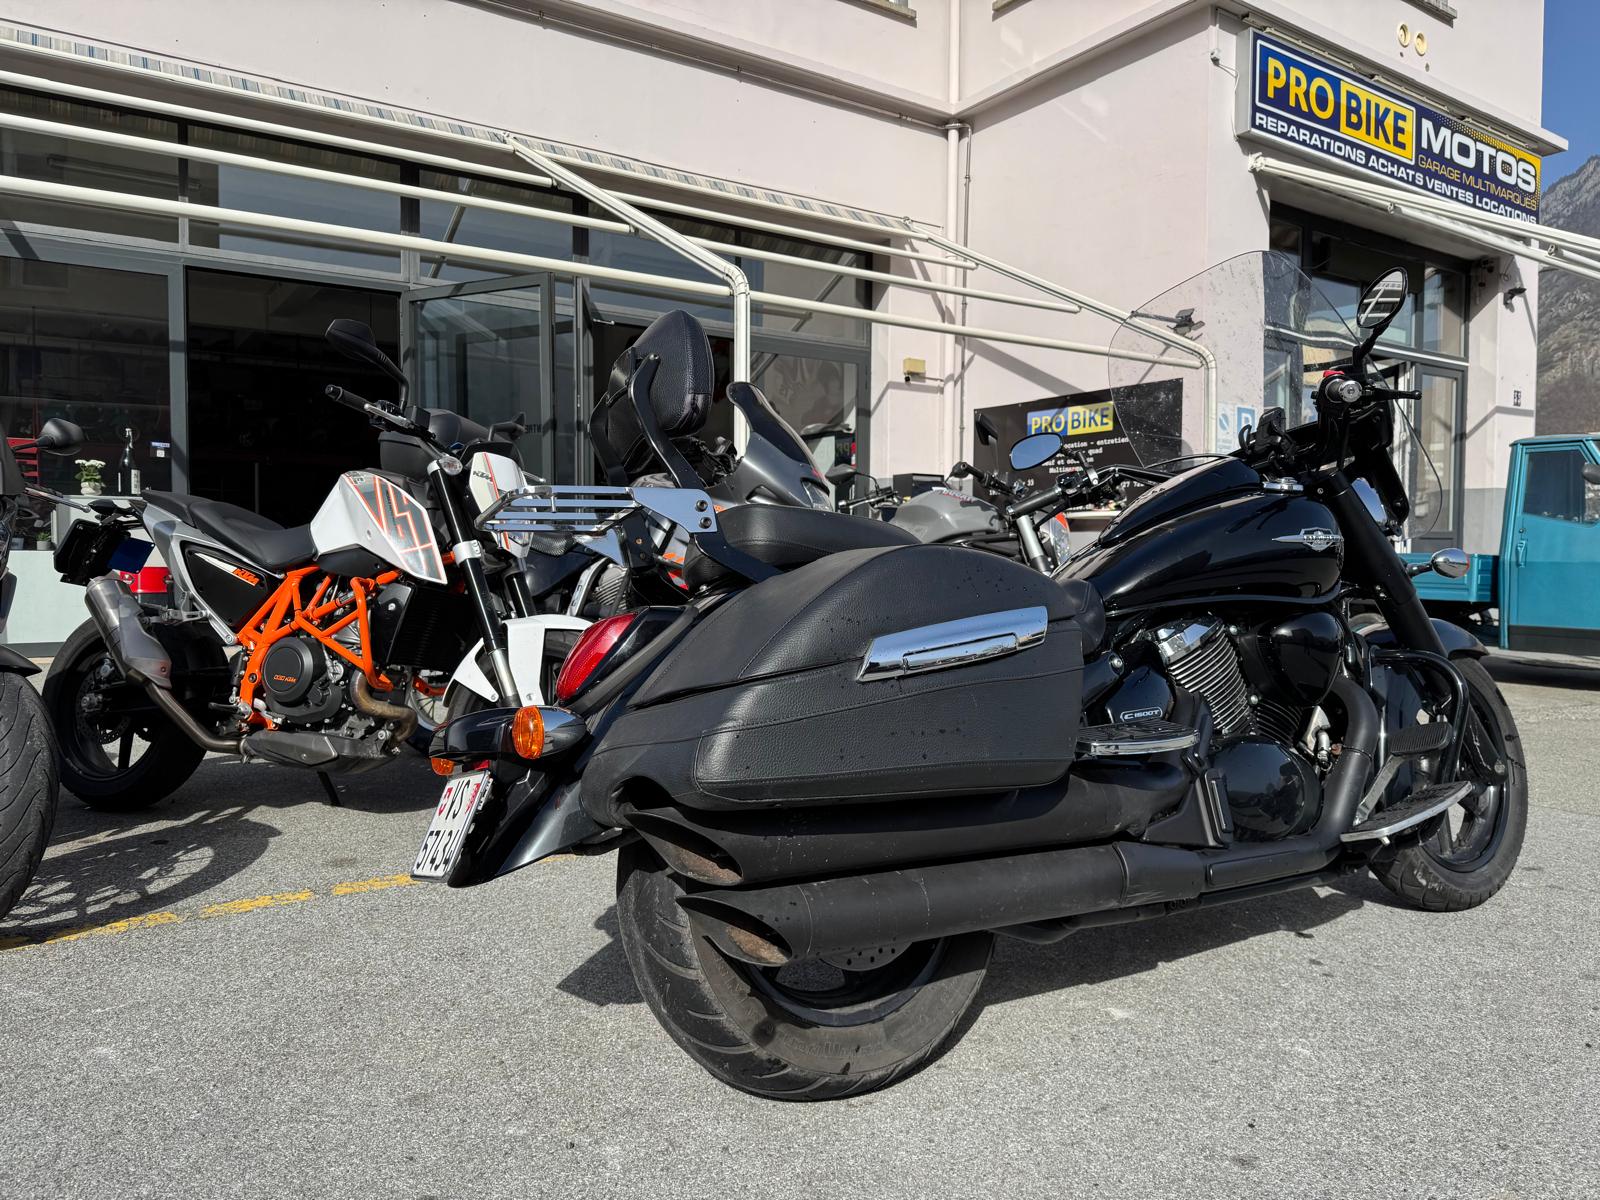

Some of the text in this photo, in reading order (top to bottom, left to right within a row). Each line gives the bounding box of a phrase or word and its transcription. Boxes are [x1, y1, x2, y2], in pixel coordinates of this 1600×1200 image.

[1267, 56, 1408, 151] PRO BIKE
[1255, 113, 1537, 224] REPARATIONS ACHATS VENTES LOCATIONS
[1420, 117, 1537, 193] MOTOS
[1418, 154, 1537, 211] GARAGE MULTIMARQUES
[1031, 406, 1110, 435] PRO BIKE
[1061, 441, 1088, 449] ocation
[1096, 436, 1129, 446] entretien
[1088, 447, 1103, 456] quad
[445, 779, 471, 820] VS
[416, 829, 460, 873] 57434
